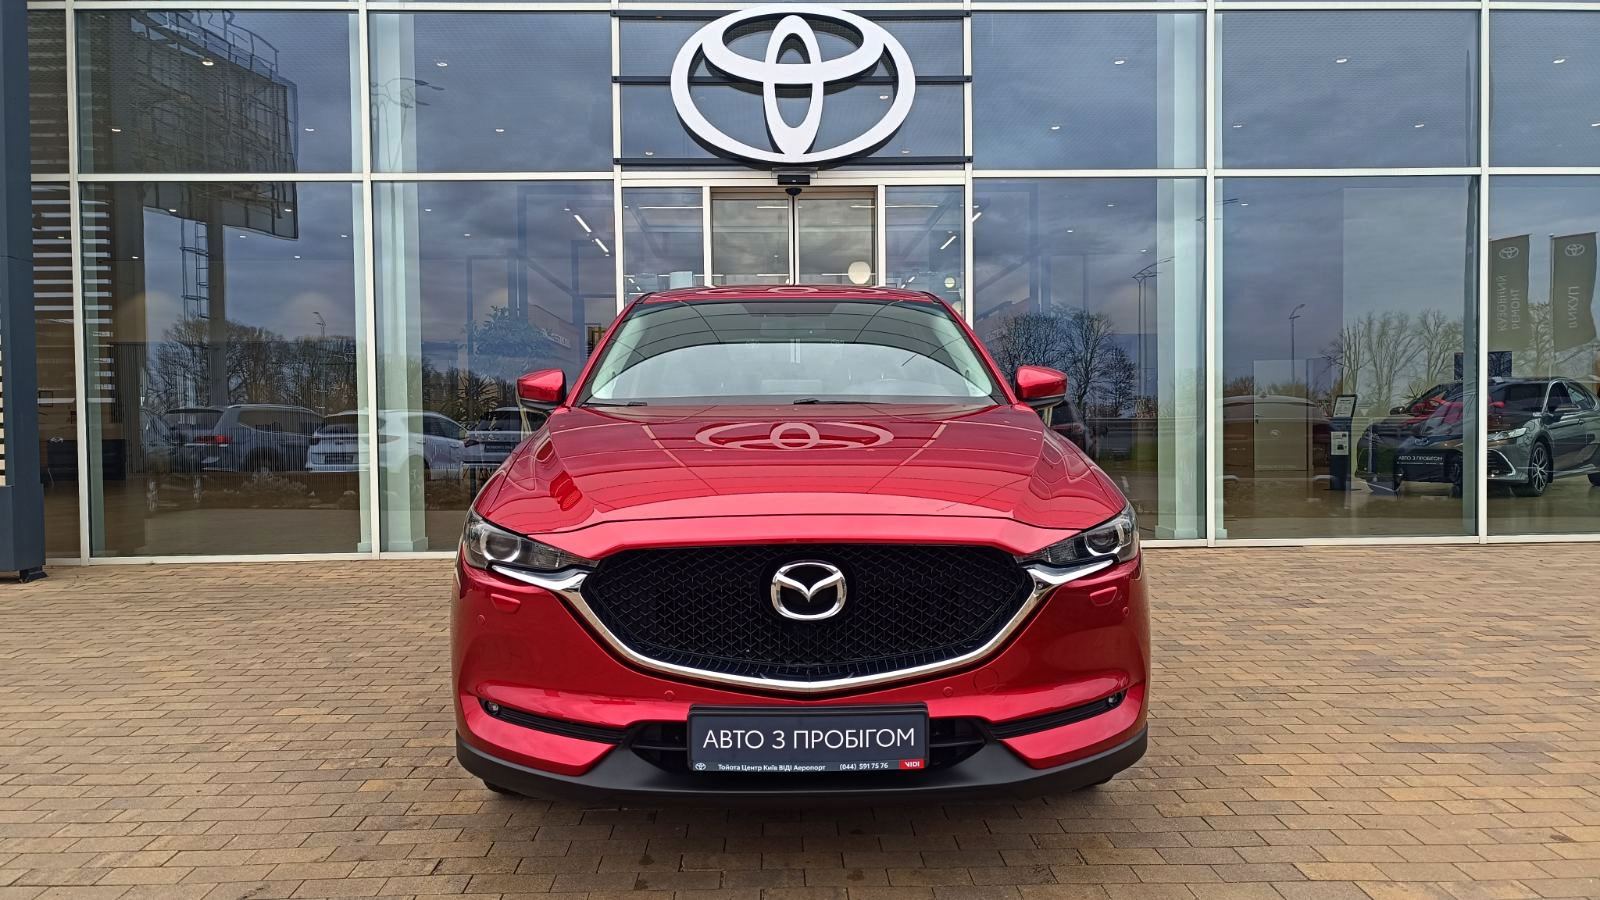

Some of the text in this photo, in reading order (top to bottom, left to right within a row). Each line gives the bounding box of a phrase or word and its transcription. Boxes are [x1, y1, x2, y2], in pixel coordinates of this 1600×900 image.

[1510, 289, 1521, 330] РЕМОНТ
[1567, 286, 1580, 328] ВИКУП
[702, 728, 915, 749] АВТО З ПРОБІГОМ
[741, 764, 762, 772] Центр
[779, 764, 793, 772] ВІДІ
[793, 764, 826, 772] Аеропорт
[840, 763, 857, 771] (044)
